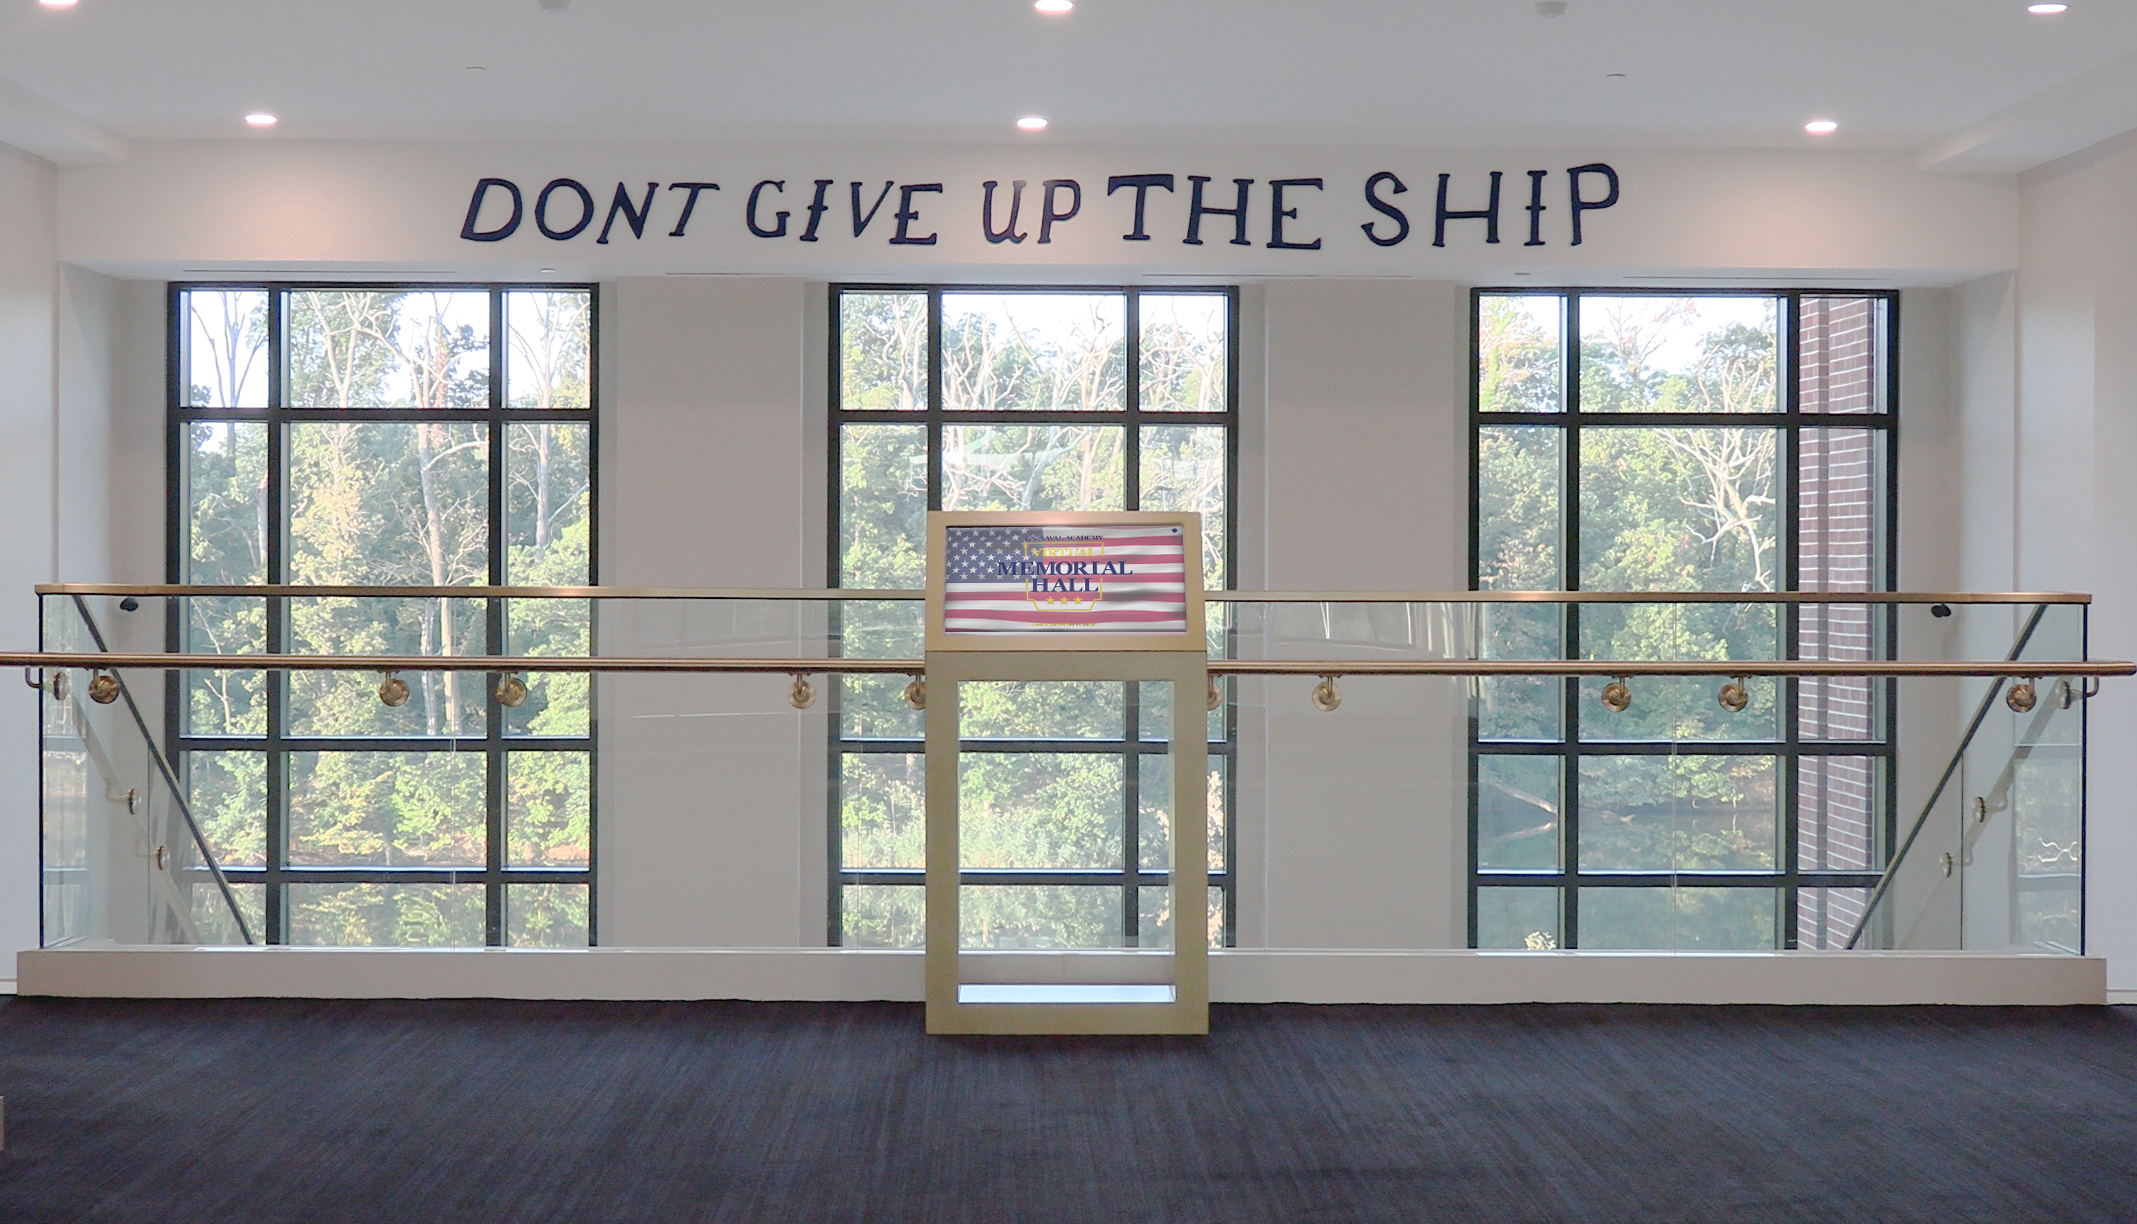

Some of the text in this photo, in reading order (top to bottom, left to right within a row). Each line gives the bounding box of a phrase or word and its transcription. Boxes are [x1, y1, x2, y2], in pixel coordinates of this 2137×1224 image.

[459, 161, 1621, 252] DONT GIVE UP THE SHIP
[1031, 547, 1098, 557] VIRTUAL
[997, 560, 1133, 576] MEMORIAL
[1030, 577, 1099, 593] HALL
